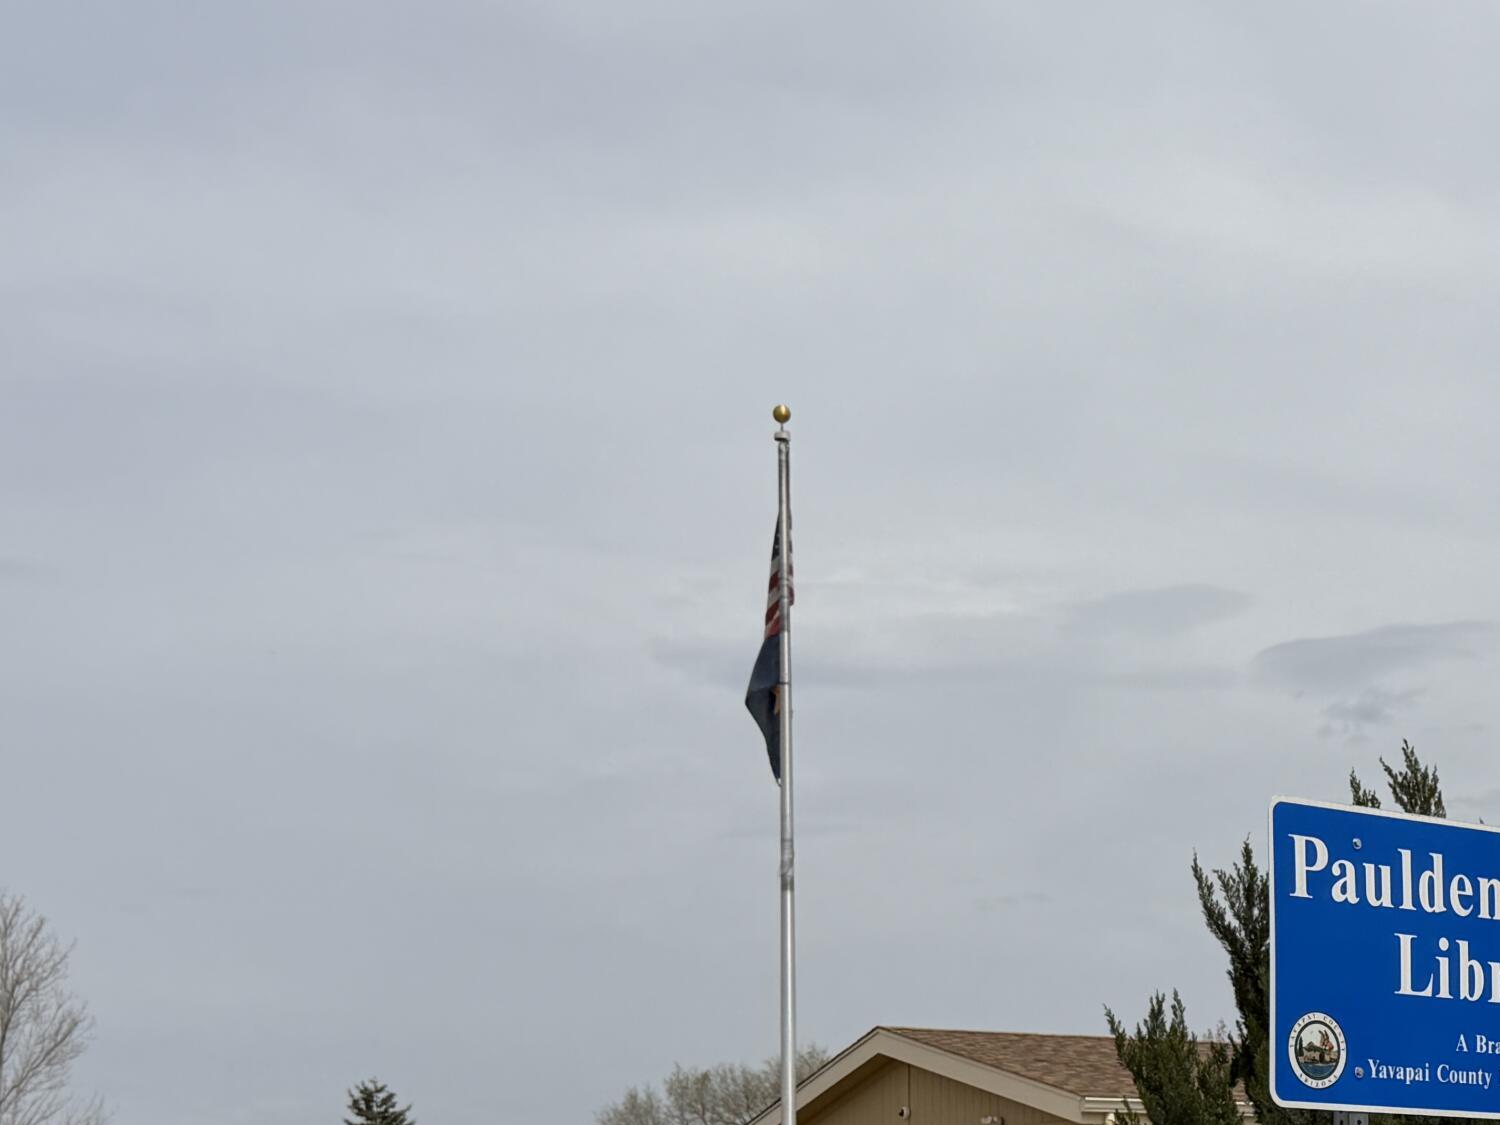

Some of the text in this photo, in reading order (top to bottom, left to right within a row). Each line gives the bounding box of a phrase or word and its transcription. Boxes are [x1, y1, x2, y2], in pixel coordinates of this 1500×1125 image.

[1456, 1033, 1468, 1052] A
[1368, 1058, 1430, 1084] Yavapai
[1437, 1063, 1492, 1089] County
